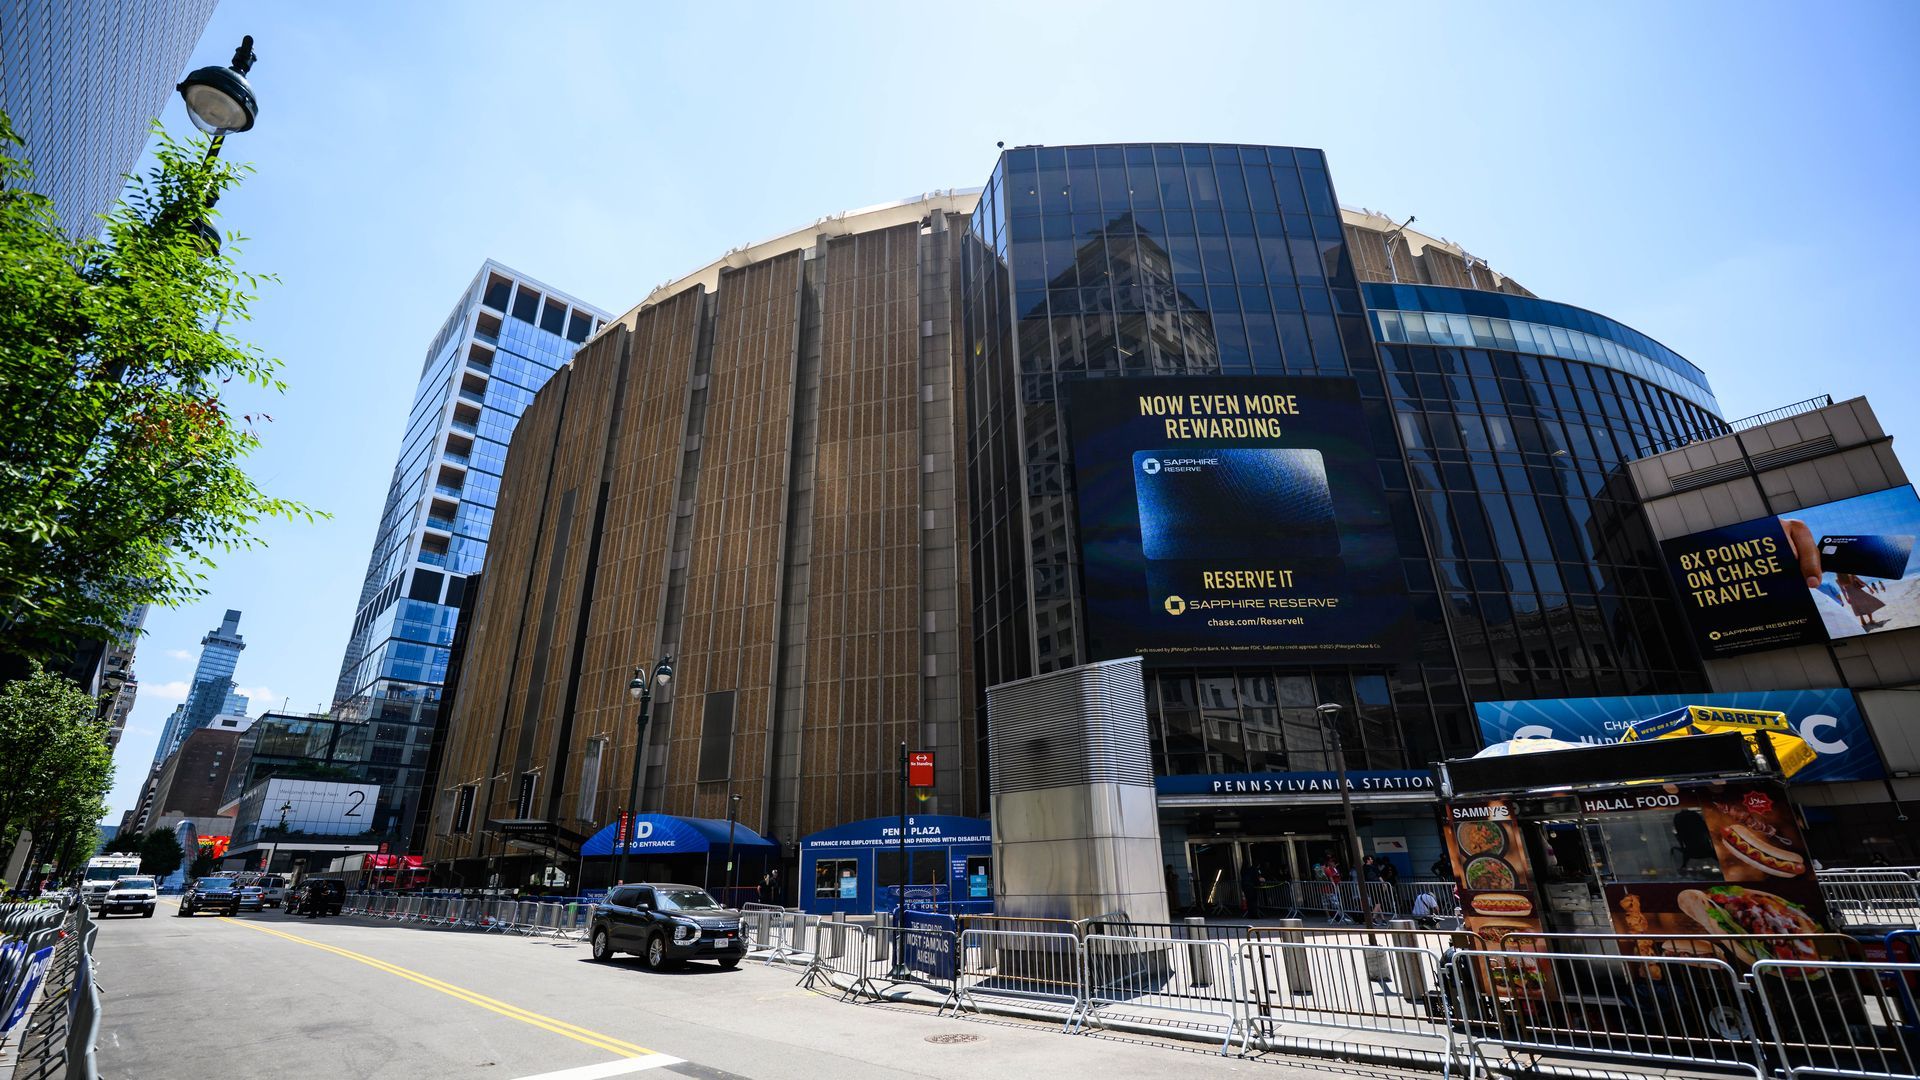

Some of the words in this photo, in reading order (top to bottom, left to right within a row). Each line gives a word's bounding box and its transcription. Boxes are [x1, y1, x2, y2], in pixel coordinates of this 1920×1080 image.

[1139, 395, 1184, 416] NOW
[1189, 395, 1240, 415] EVEN
[1245, 395, 1300, 415] MORE
[1165, 418, 1281, 439] REWARDING
[1163, 458, 1218, 466] SAPPHIRE
[1680, 552, 1705, 571] 8X
[1706, 536, 1777, 566] POINTS
[1203, 570, 1275, 589] RESERVE
[1280, 570, 1294, 588] IT
[1687, 570, 1714, 589] ON
[1717, 555, 1783, 583] CHASE
[1692, 580, 1768, 608] TRAVEL
[1189, 599, 1266, 610] SAPPHIRE
[1207, 616, 1304, 627] chase.com/ReserveIt
[1722, 625, 1764, 637] SAPPHIRE
[1603, 719, 1637, 731] CHA
[1697, 709, 1781, 726] SABRETT
[1800, 714, 1849, 755] C
[1213, 778, 1354, 792] PENNSYLVANIA
[1362, 776, 1434, 790] STATION
[344, 790, 365, 817] 2
[1585, 798, 1634, 812] HALAL
[1637, 794, 1680, 808] FOOD
[1452, 804, 1509, 819] SAMMY'S
[908, 817, 915, 826] 8
[637, 821, 653, 839] D
[882, 827, 907, 836] PEN
[911, 826, 941, 836] PLAZA
[639, 840, 676, 848] ENTRANCE
[907, 933, 922, 948] MOST
